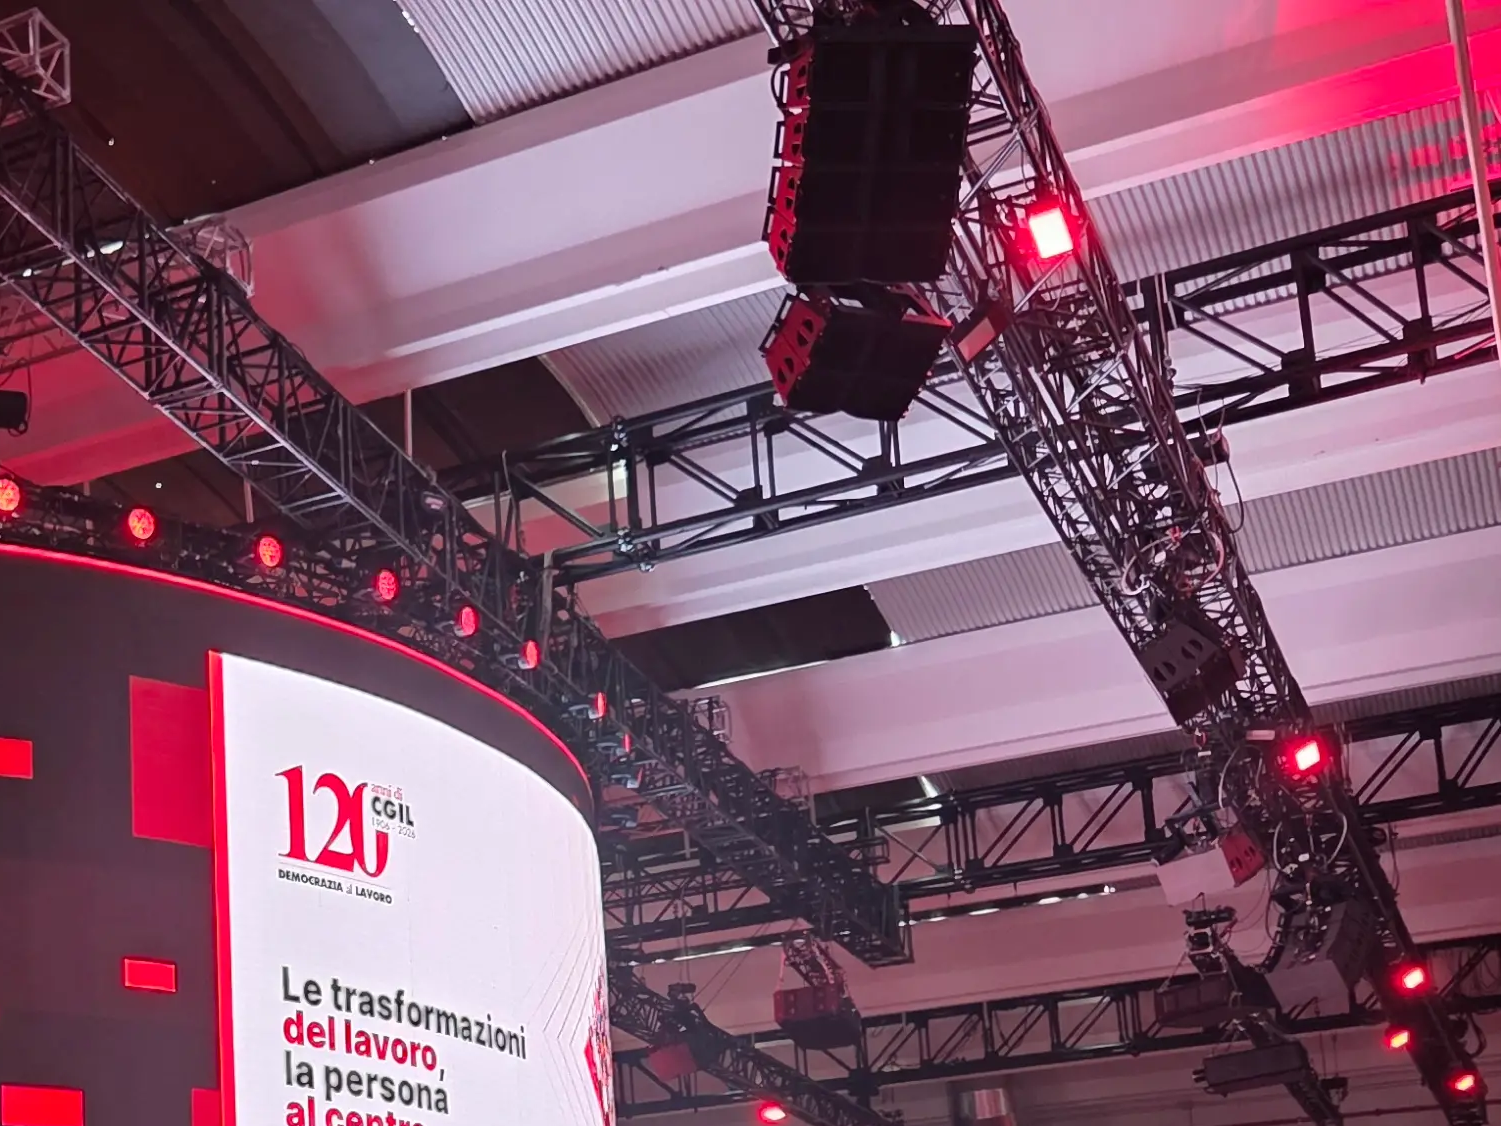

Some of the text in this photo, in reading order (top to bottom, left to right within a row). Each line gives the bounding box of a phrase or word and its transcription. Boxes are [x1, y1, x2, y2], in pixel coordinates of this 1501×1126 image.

[275, 765, 389, 877] 120
[371, 796, 414, 827] CGIL
[278, 869, 392, 904] DEMOCRAZIA al LAVORO
[282, 966, 526, 1060] Le trasformazioni
[283, 1010, 445, 1081] del lavoro,
[285, 1050, 449, 1114] la persona
